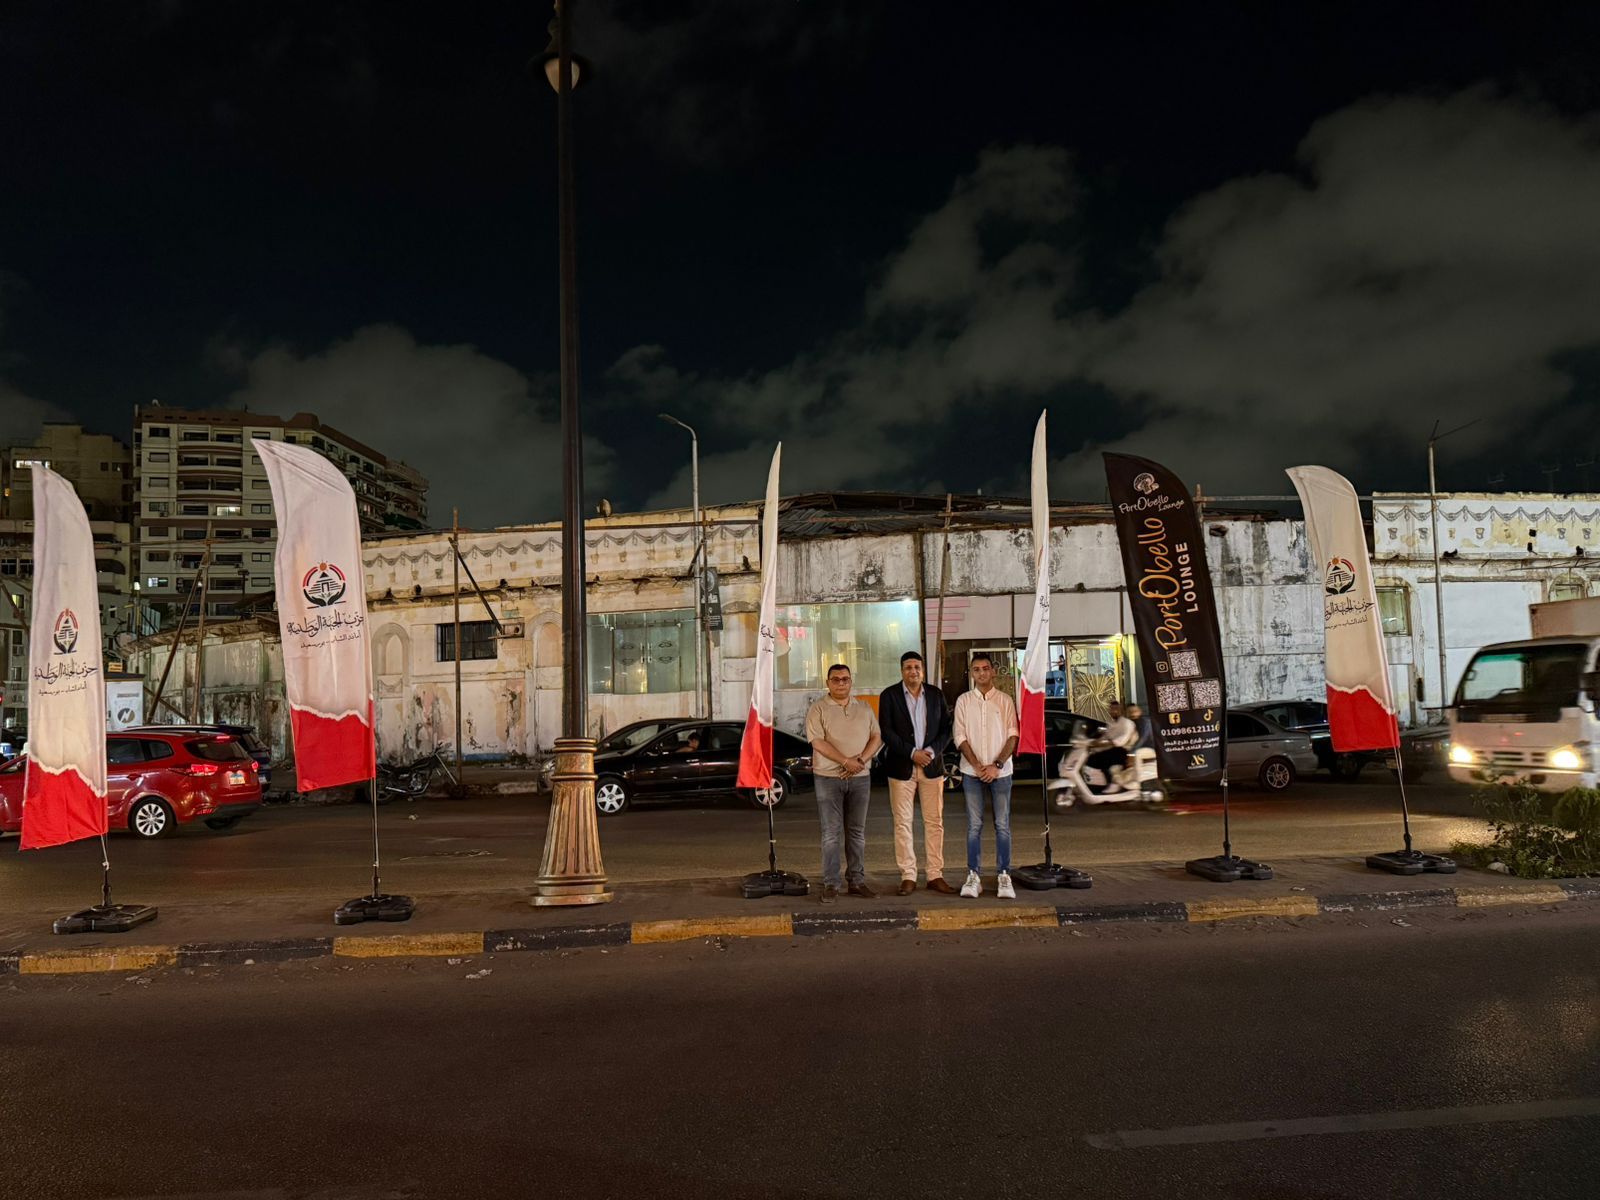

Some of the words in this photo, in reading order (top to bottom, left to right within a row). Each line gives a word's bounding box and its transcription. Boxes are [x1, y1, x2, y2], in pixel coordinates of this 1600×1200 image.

[1119, 495, 1169, 514] PortObello
[1158, 500, 1185, 512] Lounge
[1137, 517, 1188, 650] PortObello
[1175, 542, 1199, 613] LOUNGE
[1355, 598, 1375, 613] حزب
[76, 661, 98, 679] حزب
